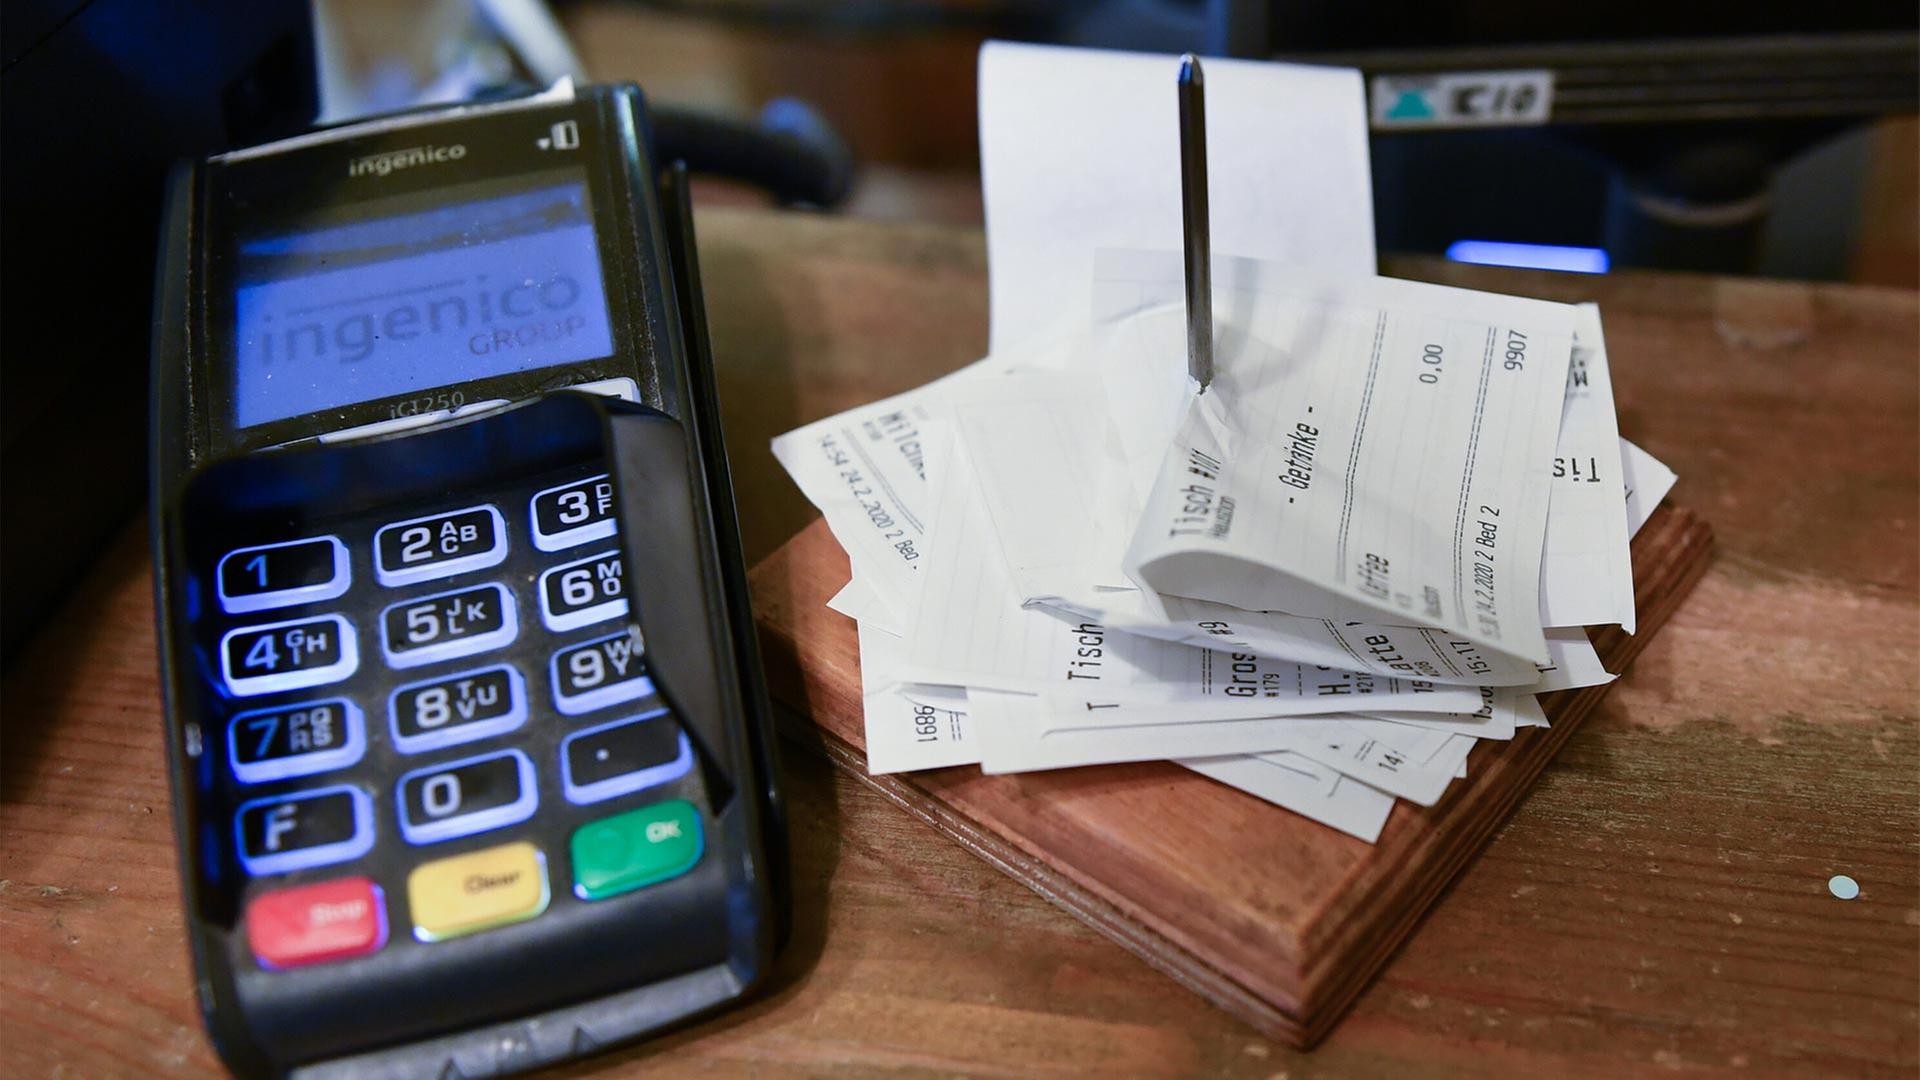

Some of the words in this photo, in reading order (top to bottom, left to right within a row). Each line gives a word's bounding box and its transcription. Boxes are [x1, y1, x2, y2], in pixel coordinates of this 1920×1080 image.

[350, 143, 467, 177] ingenico
[262, 274, 580, 365] ingenico
[468, 315, 586, 356] GROUP
[1419, 343, 1444, 384] 0,00
[1503, 329, 1528, 371] 9907
[557, 490, 590, 524] 3
[1479, 504, 1500, 517] 2
[400, 527, 433, 563] 2
[1475, 520, 1498, 548] Bed
[245, 555, 268, 588] 1
[1474, 550, 1494, 562] 2
[560, 569, 595, 606] 6
[406, 603, 440, 643] 5
[244, 634, 281, 670] 4
[569, 648, 606, 689] 9
[1067, 622, 1104, 680] Tisch
[1449, 640, 1492, 675] 15:17
[1263, 672, 1281, 698] #179
[415, 687, 452, 729] 8
[913, 704, 939, 743] 9891
[247, 717, 280, 757] 7
[263, 803, 297, 851] F
[645, 819, 681, 843] OK
[463, 869, 521, 895] Clear
